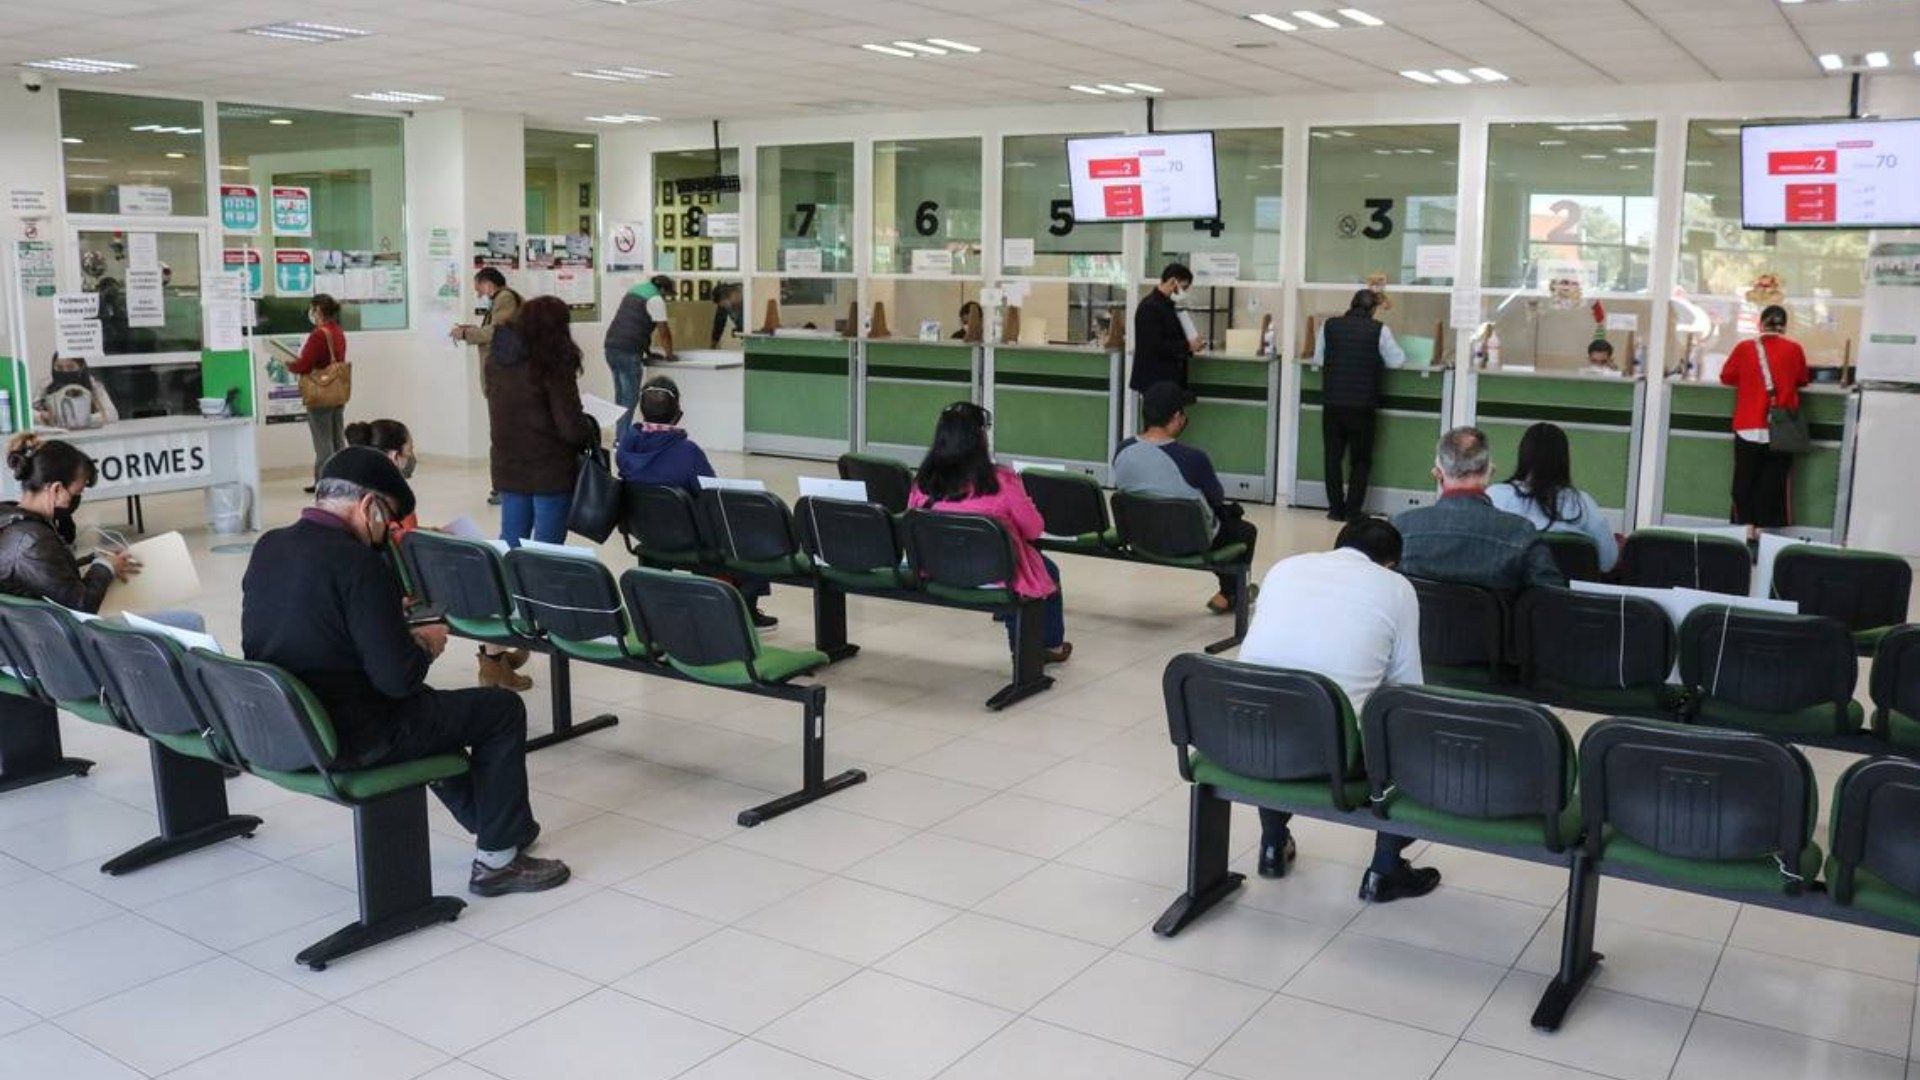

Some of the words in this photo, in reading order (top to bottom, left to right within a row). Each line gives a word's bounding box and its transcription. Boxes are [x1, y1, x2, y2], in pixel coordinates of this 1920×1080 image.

[1168, 160, 1183, 172] 70
[1815, 156, 1826, 170] 2
[1876, 155, 1898, 168] 70
[687, 206, 703, 237] 8
[795, 203, 816, 237] 7
[916, 200, 940, 236] 6
[1049, 199, 1074, 237] 5
[1362, 198, 1393, 239] 3
[1547, 199, 1581, 243] 2
